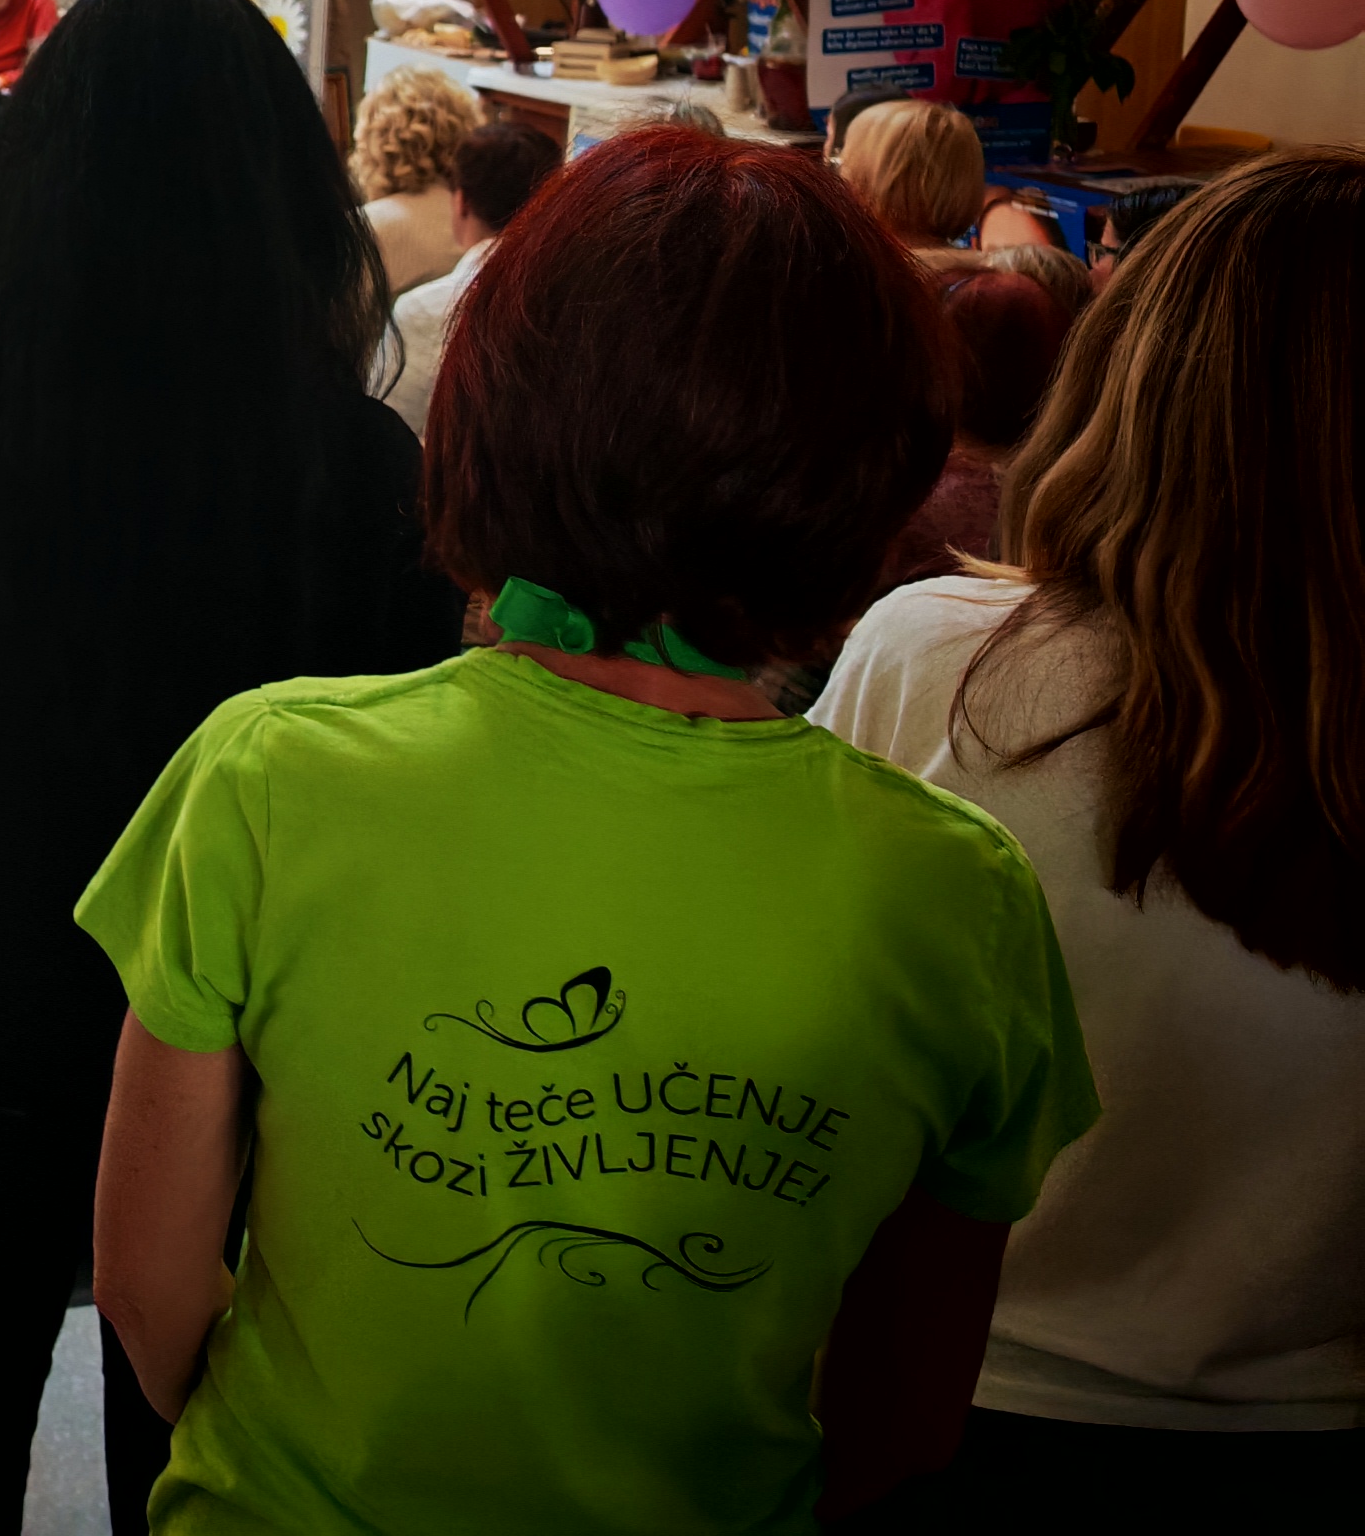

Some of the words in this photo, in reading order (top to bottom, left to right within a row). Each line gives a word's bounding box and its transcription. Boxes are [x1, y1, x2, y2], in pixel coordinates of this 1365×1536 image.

[387, 1052, 470, 1132] Naj
[487, 1084, 595, 1133] teče
[613, 1062, 851, 1152] UČENJE
[360, 1112, 488, 1196] skozi
[505, 1131, 830, 1206] ŽIVLJENJE!
